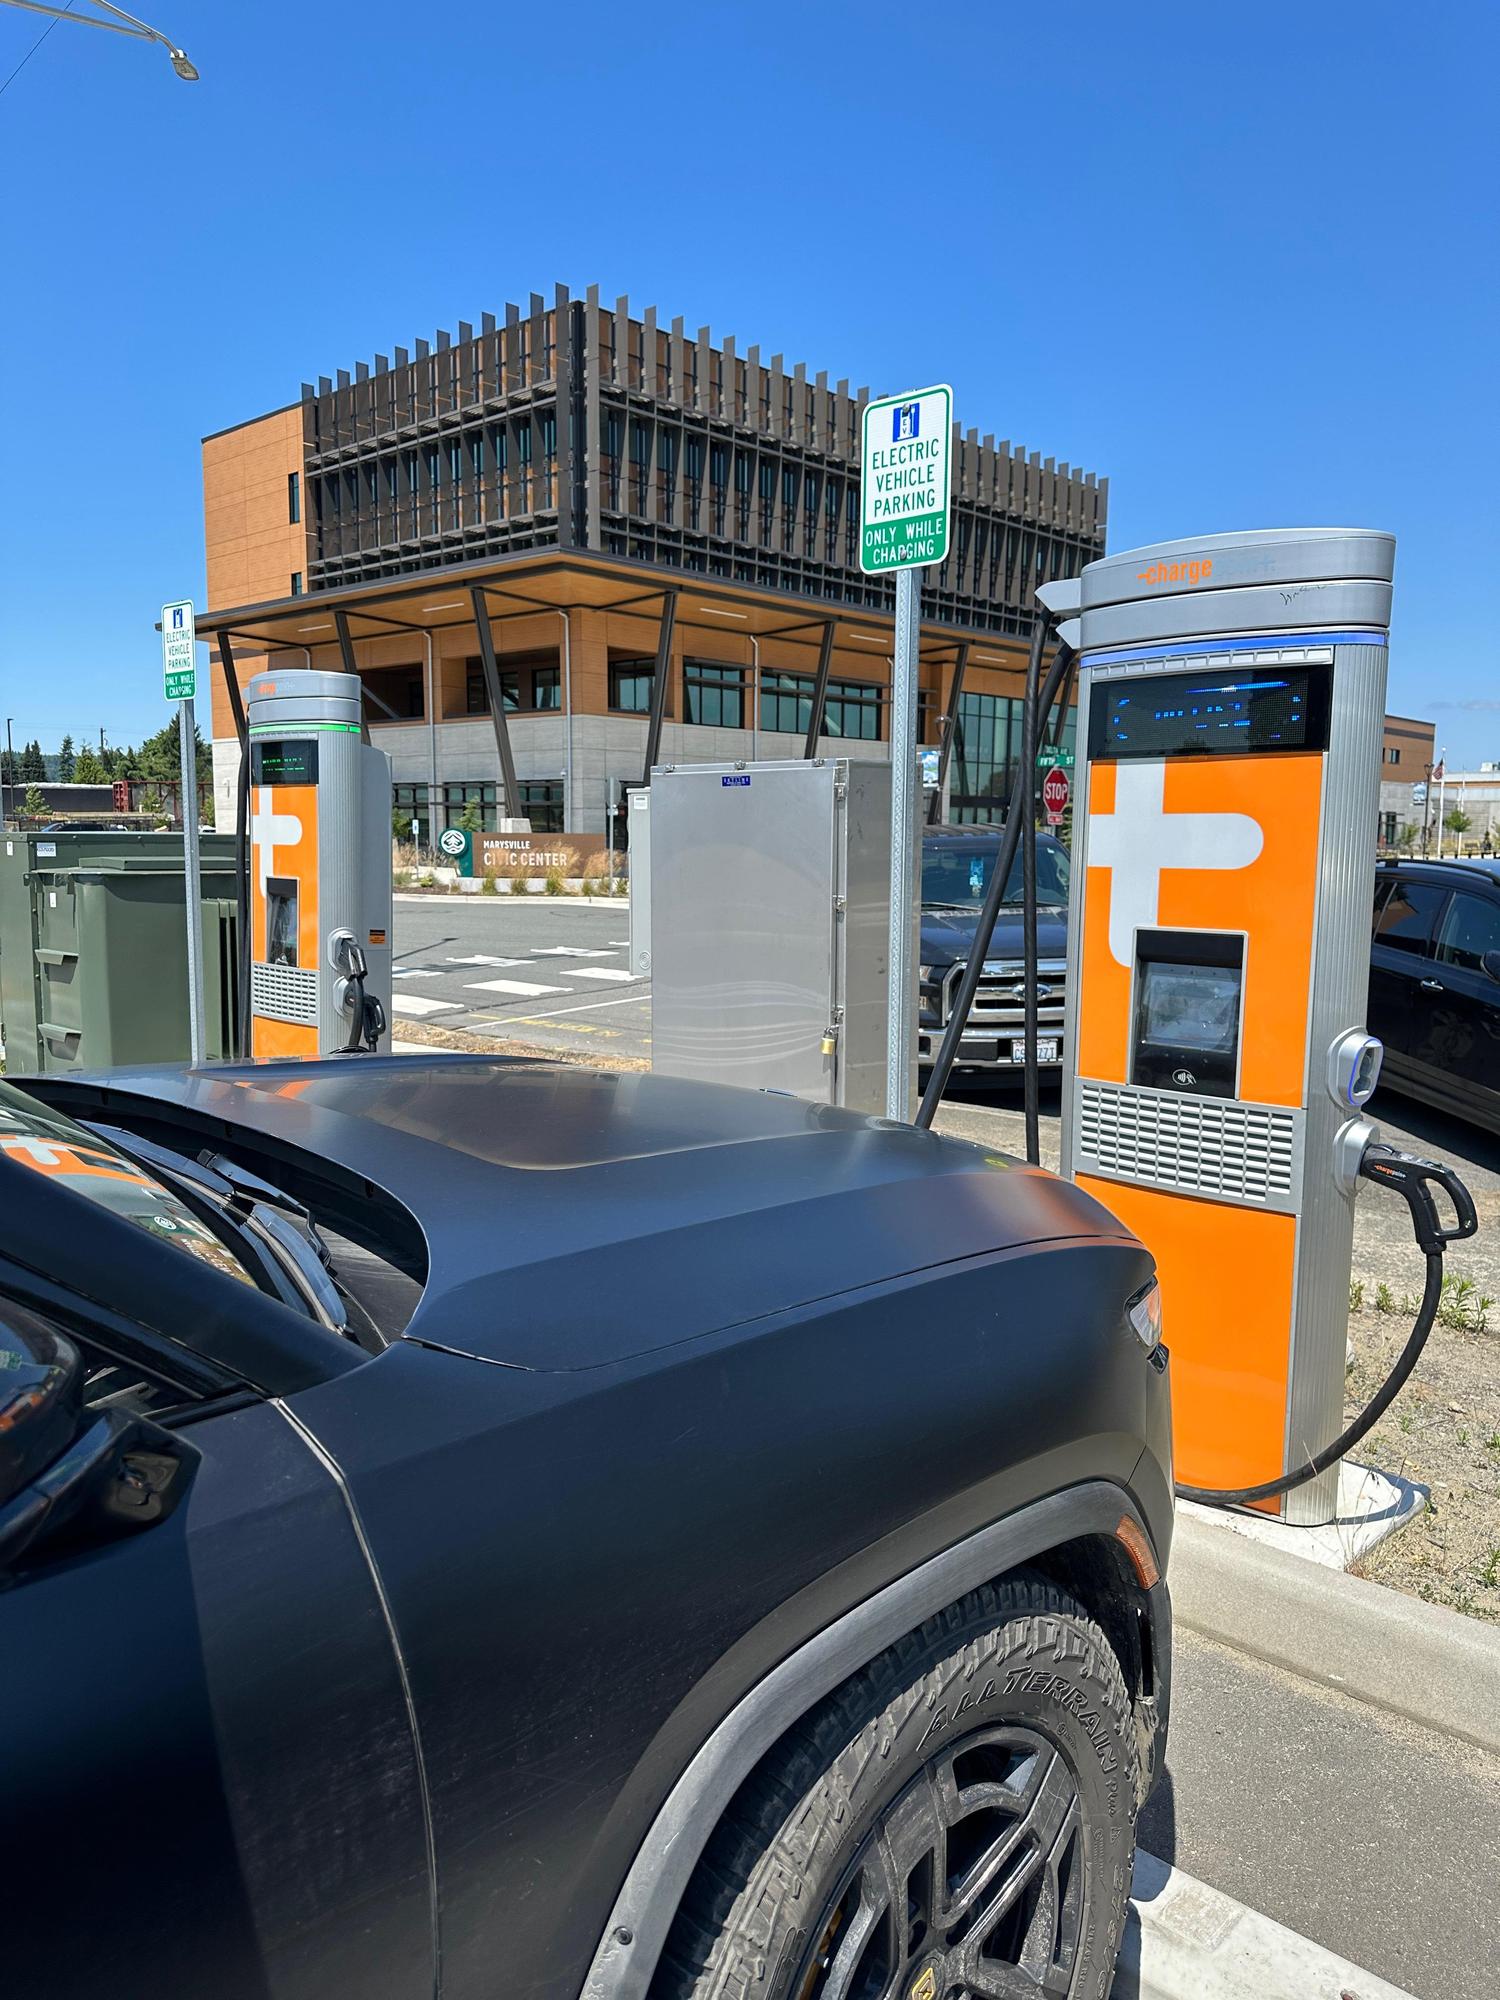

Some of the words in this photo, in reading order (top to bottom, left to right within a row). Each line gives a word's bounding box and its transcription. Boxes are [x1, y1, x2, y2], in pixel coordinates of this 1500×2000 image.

[872, 438, 940, 470] ELECTRIC
[876, 463, 935, 493] VEHICLE
[874, 488, 936, 518] PARKING
[865, 526, 897, 547] ONLY
[905, 517, 943, 540] WHILE
[166, 629, 191, 643] ELECTRIC
[168, 643, 190, 656] VEHICLE
[168, 657, 191, 670] PARKING
[166, 675, 178, 686] ONLY
[1045, 782, 1068, 800] STOP
[483, 840, 531, 849] MARYSVILLE
[520, 852, 567, 866] CENTER
[1002, 1664, 1118, 1775] TERRAIN
